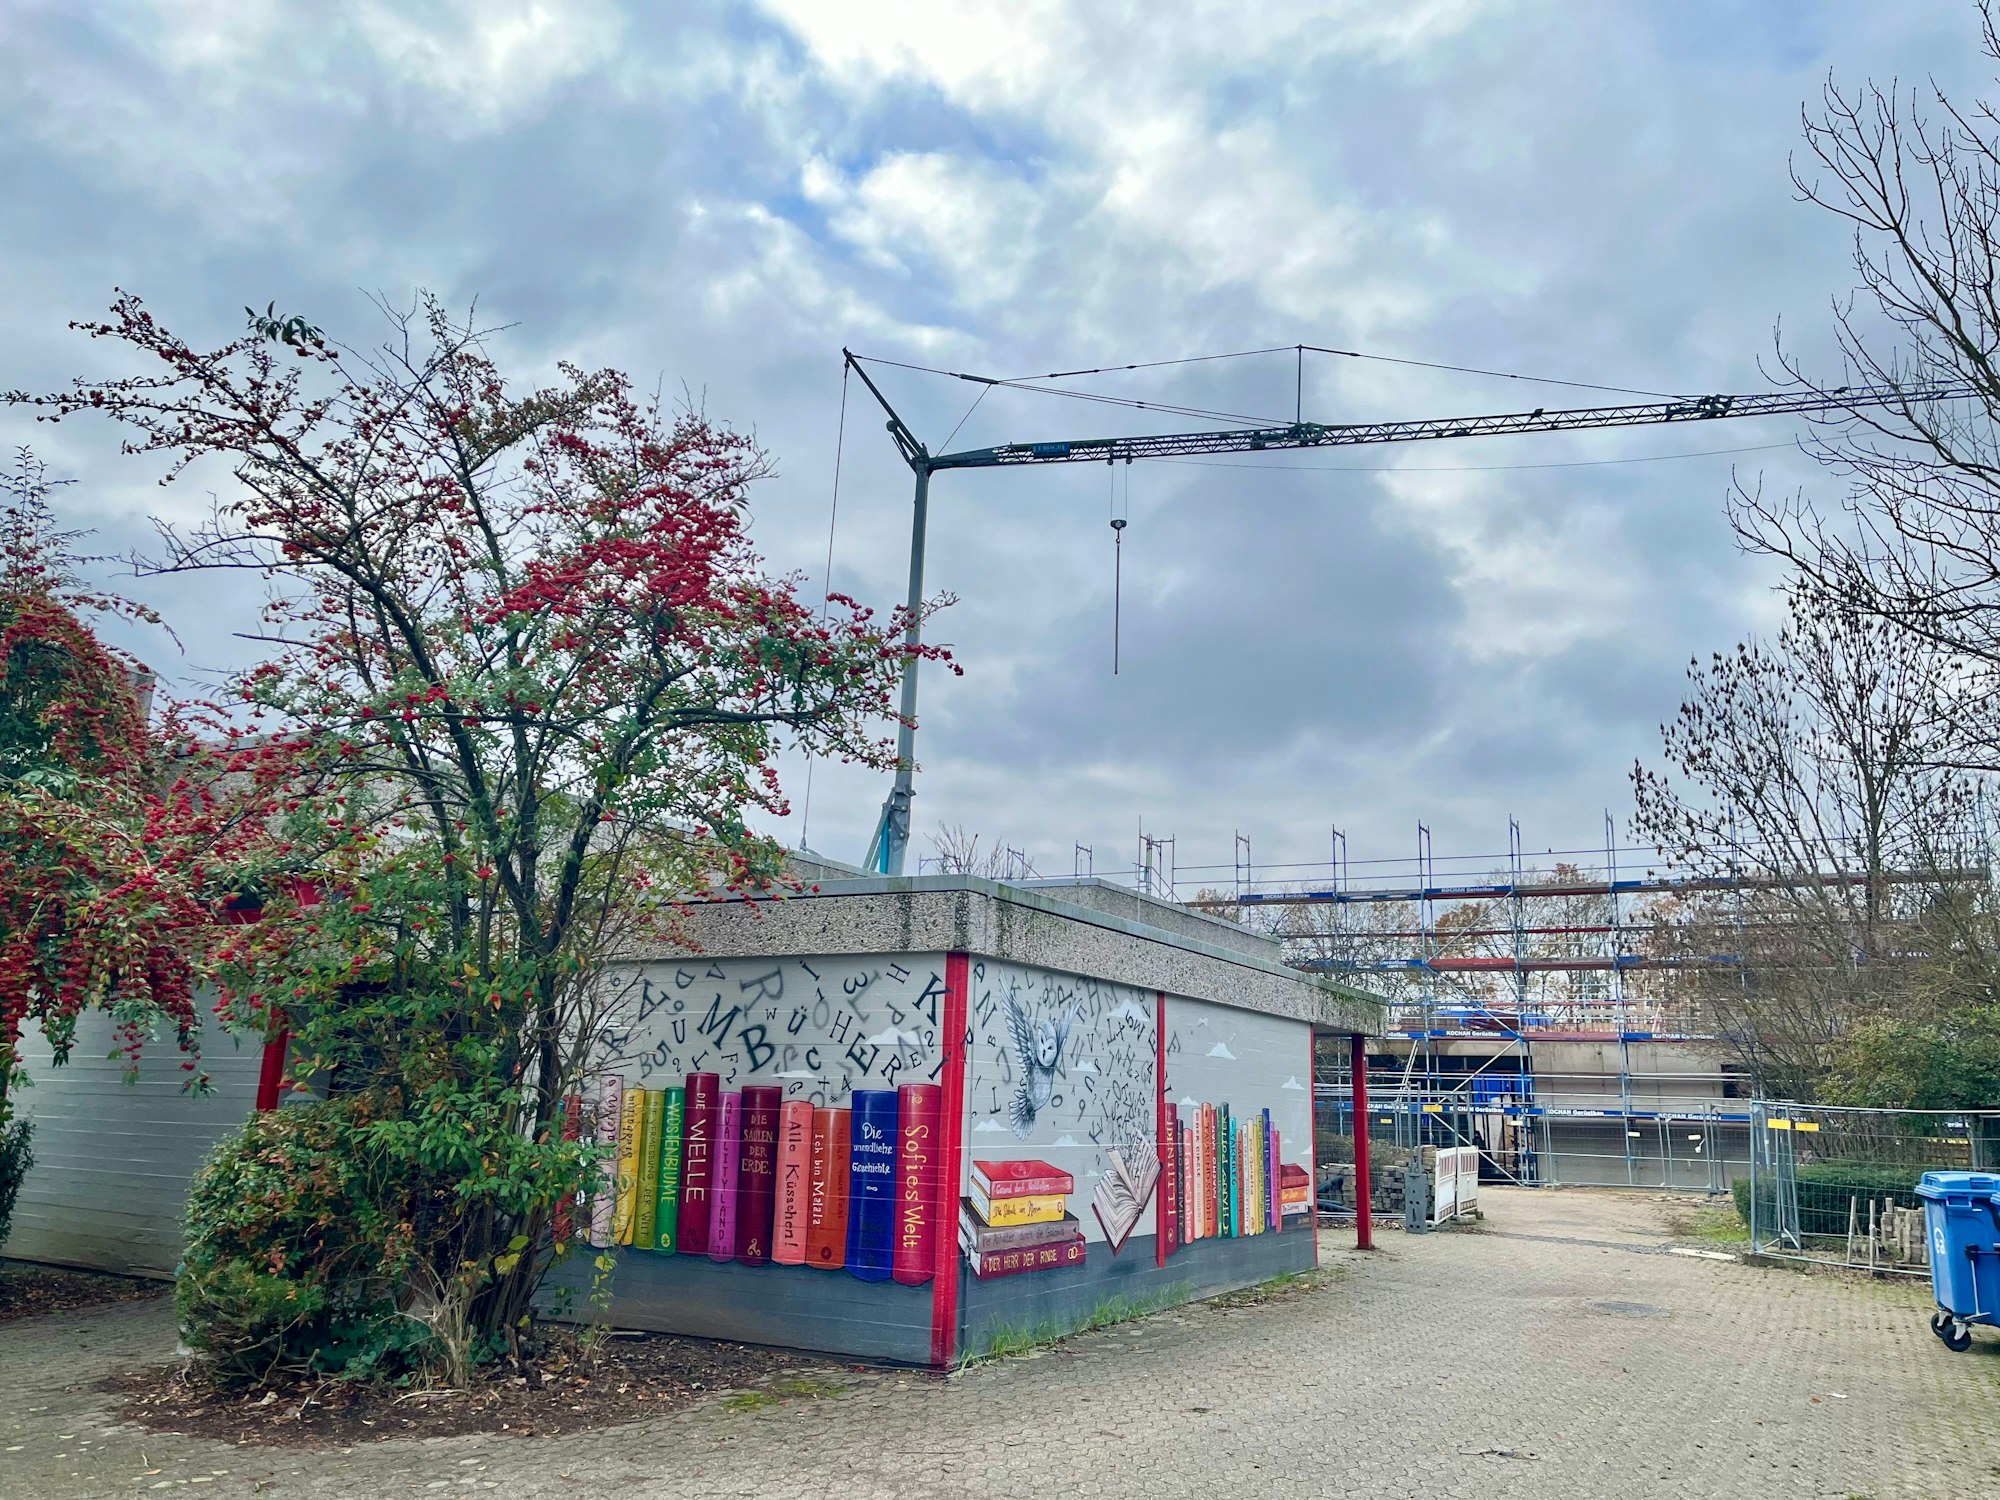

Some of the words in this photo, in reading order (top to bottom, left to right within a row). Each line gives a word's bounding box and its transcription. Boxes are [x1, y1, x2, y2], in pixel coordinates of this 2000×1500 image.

[675, 968, 696, 989] D
[885, 962, 911, 985] H
[638, 978, 671, 1022] A
[739, 965, 784, 1023] R
[912, 971, 952, 1027] K
[697, 992, 742, 1051] M
[765, 1007, 778, 1021] W
[975, 989, 997, 1030] N
[671, 1018, 686, 1045] U
[829, 1009, 853, 1044] H
[736, 1023, 776, 1074] B
[844, 1031, 880, 1077] E
[908, 1051, 922, 1069] E
[880, 1053, 902, 1087] R
[694, 1092, 706, 1110] DIE
[750, 1114, 768, 1125] DIE
[861, 1121, 883, 1141] Die
[749, 1145, 768, 1158] DER
[787, 1120, 802, 1153] Alle
[814, 1134, 825, 1154] Ich
[853, 1143, 893, 1155] unendliche
[685, 1118, 706, 1204] WELLE
[814, 1159, 824, 1176] bin
[901, 1125, 929, 1201] Sofies
[643, 1188, 652, 1206] DER
[783, 1164, 800, 1248] Küsschen!
[812, 1181, 825, 1226] Malala
[639, 1210, 652, 1237] WELT
[902, 1204, 926, 1249] Welt
[988, 1257, 1001, 1272] DER
[1003, 1254, 1019, 1269] HERR
[1023, 1252, 1035, 1267] DER
[1039, 1248, 1058, 1265] RINGE
